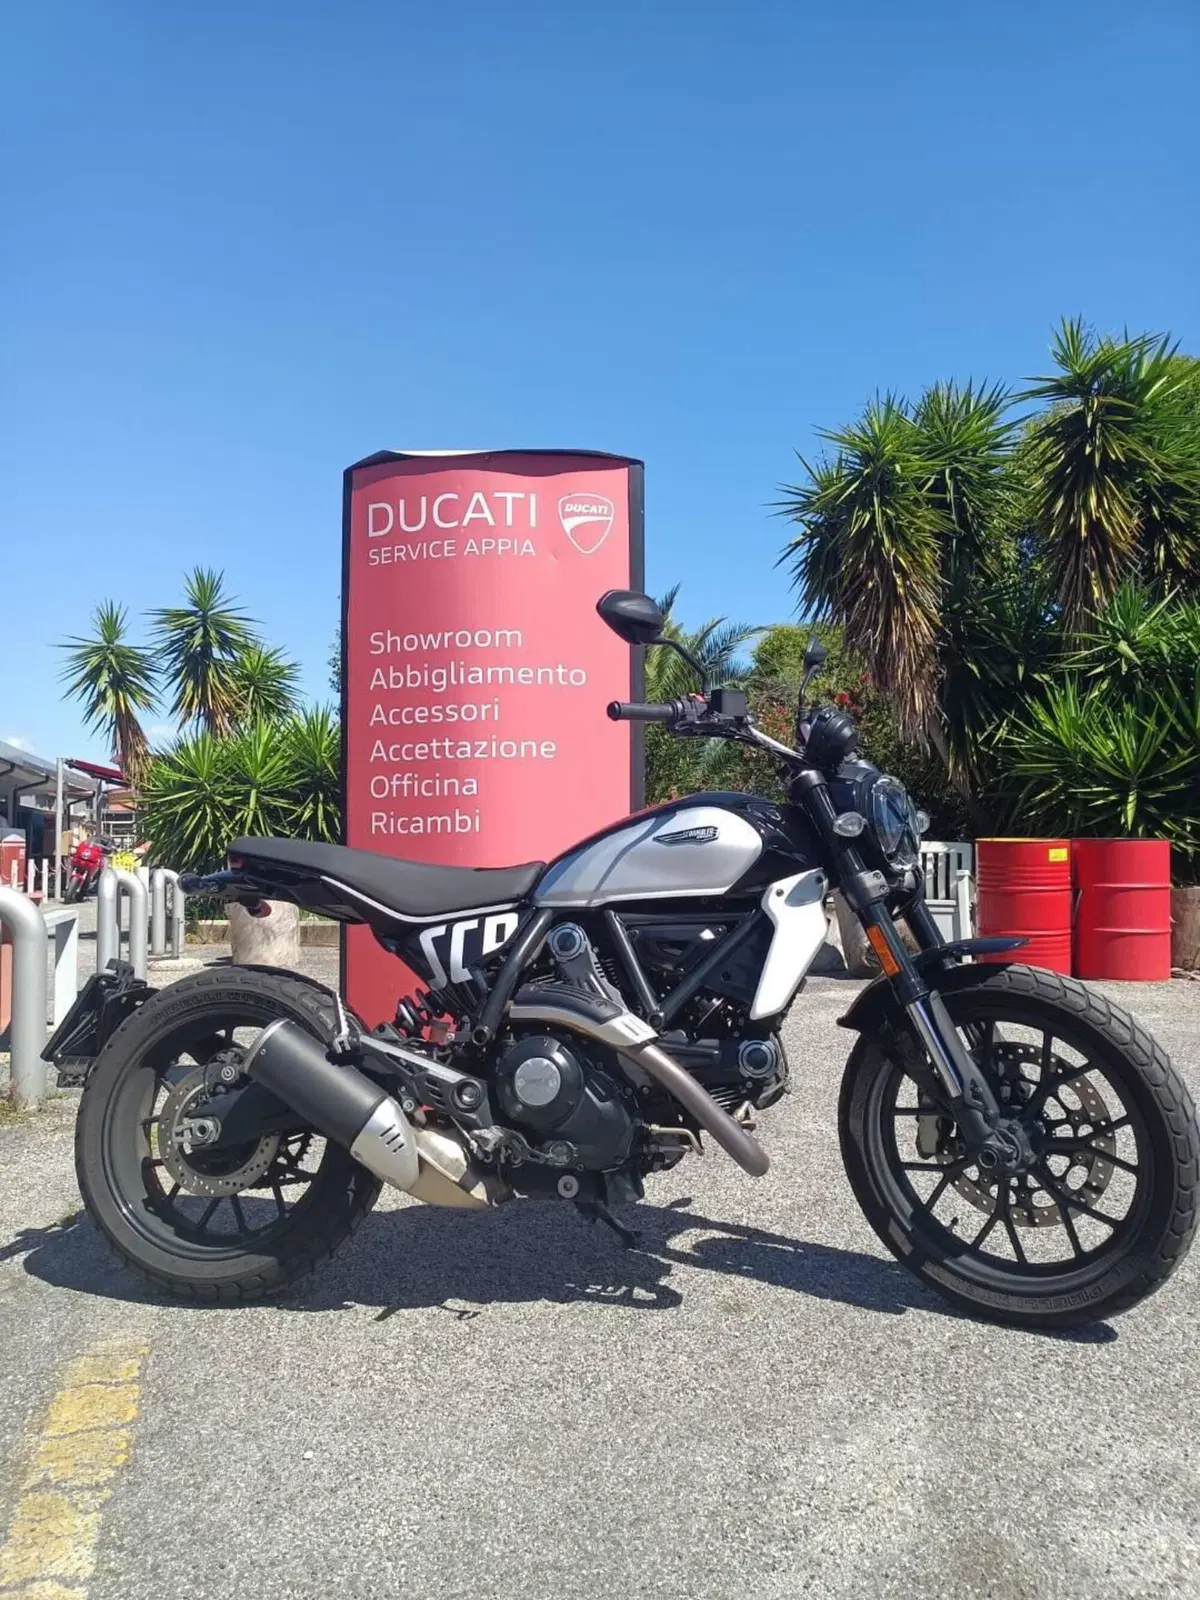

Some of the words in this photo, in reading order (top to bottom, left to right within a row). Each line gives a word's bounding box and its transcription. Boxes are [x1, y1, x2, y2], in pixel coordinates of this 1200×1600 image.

[368, 492, 537, 538] DUCATI
[564, 503, 608, 515] DUCATI
[368, 540, 457, 566] SERVICE
[463, 538, 536, 556] APPIA
[369, 629, 523, 655] Showroom
[369, 661, 587, 693] Abbigliamento
[369, 697, 500, 727] Accessori
[369, 734, 557, 762] Accettazione
[370, 772, 479, 799] Officina
[371, 808, 481, 835] Ricambi
